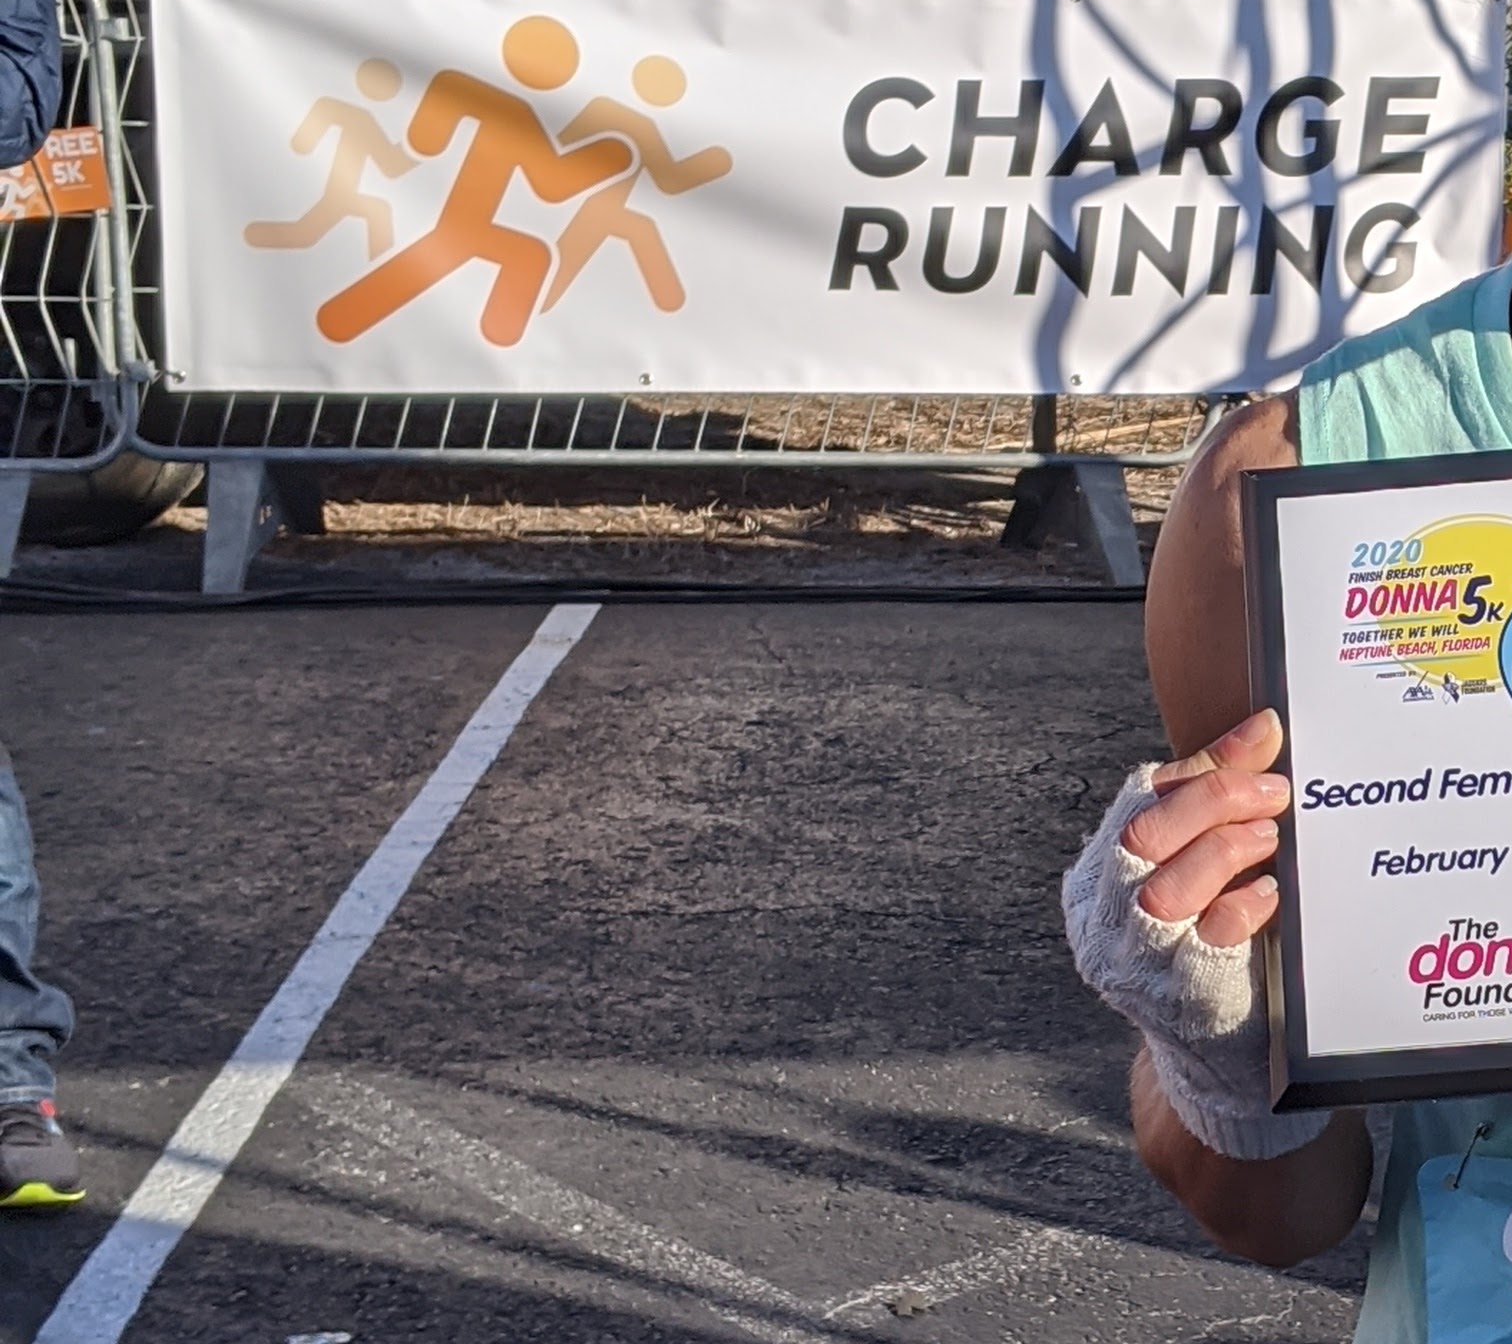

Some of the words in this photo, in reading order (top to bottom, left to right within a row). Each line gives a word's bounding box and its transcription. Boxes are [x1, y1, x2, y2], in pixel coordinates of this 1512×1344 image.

[842, 76, 1440, 178] CHARGE
[44, 131, 98, 159] REE
[52, 159, 86, 184] 5K
[828, 202, 1421, 299] RUNNING
[1351, 539, 1422, 567] 2020
[1348, 571, 1383, 584] FINISH
[1385, 567, 1427, 581] BREAST
[1430, 563, 1473, 577] CANCER
[1345, 579, 1458, 619] DONNA
[1458, 575, 1504, 625] 5K
[1342, 628, 1404, 644] TOGETHER
[1408, 626, 1426, 638] WE
[1432, 624, 1459, 636] WILL
[1339, 644, 1394, 661] NEPTUNE
[1397, 641, 1438, 656] BEACH,
[1441, 636, 1491, 652] FLORIDA
[1301, 768, 1433, 810] Second
[1371, 846, 1509, 877] February
[1449, 918, 1499, 941] The
[1423, 1013, 1456, 1022] CARING
[1458, 1011, 1475, 1019] FOR
[1478, 1010, 1506, 1018] THOSE
